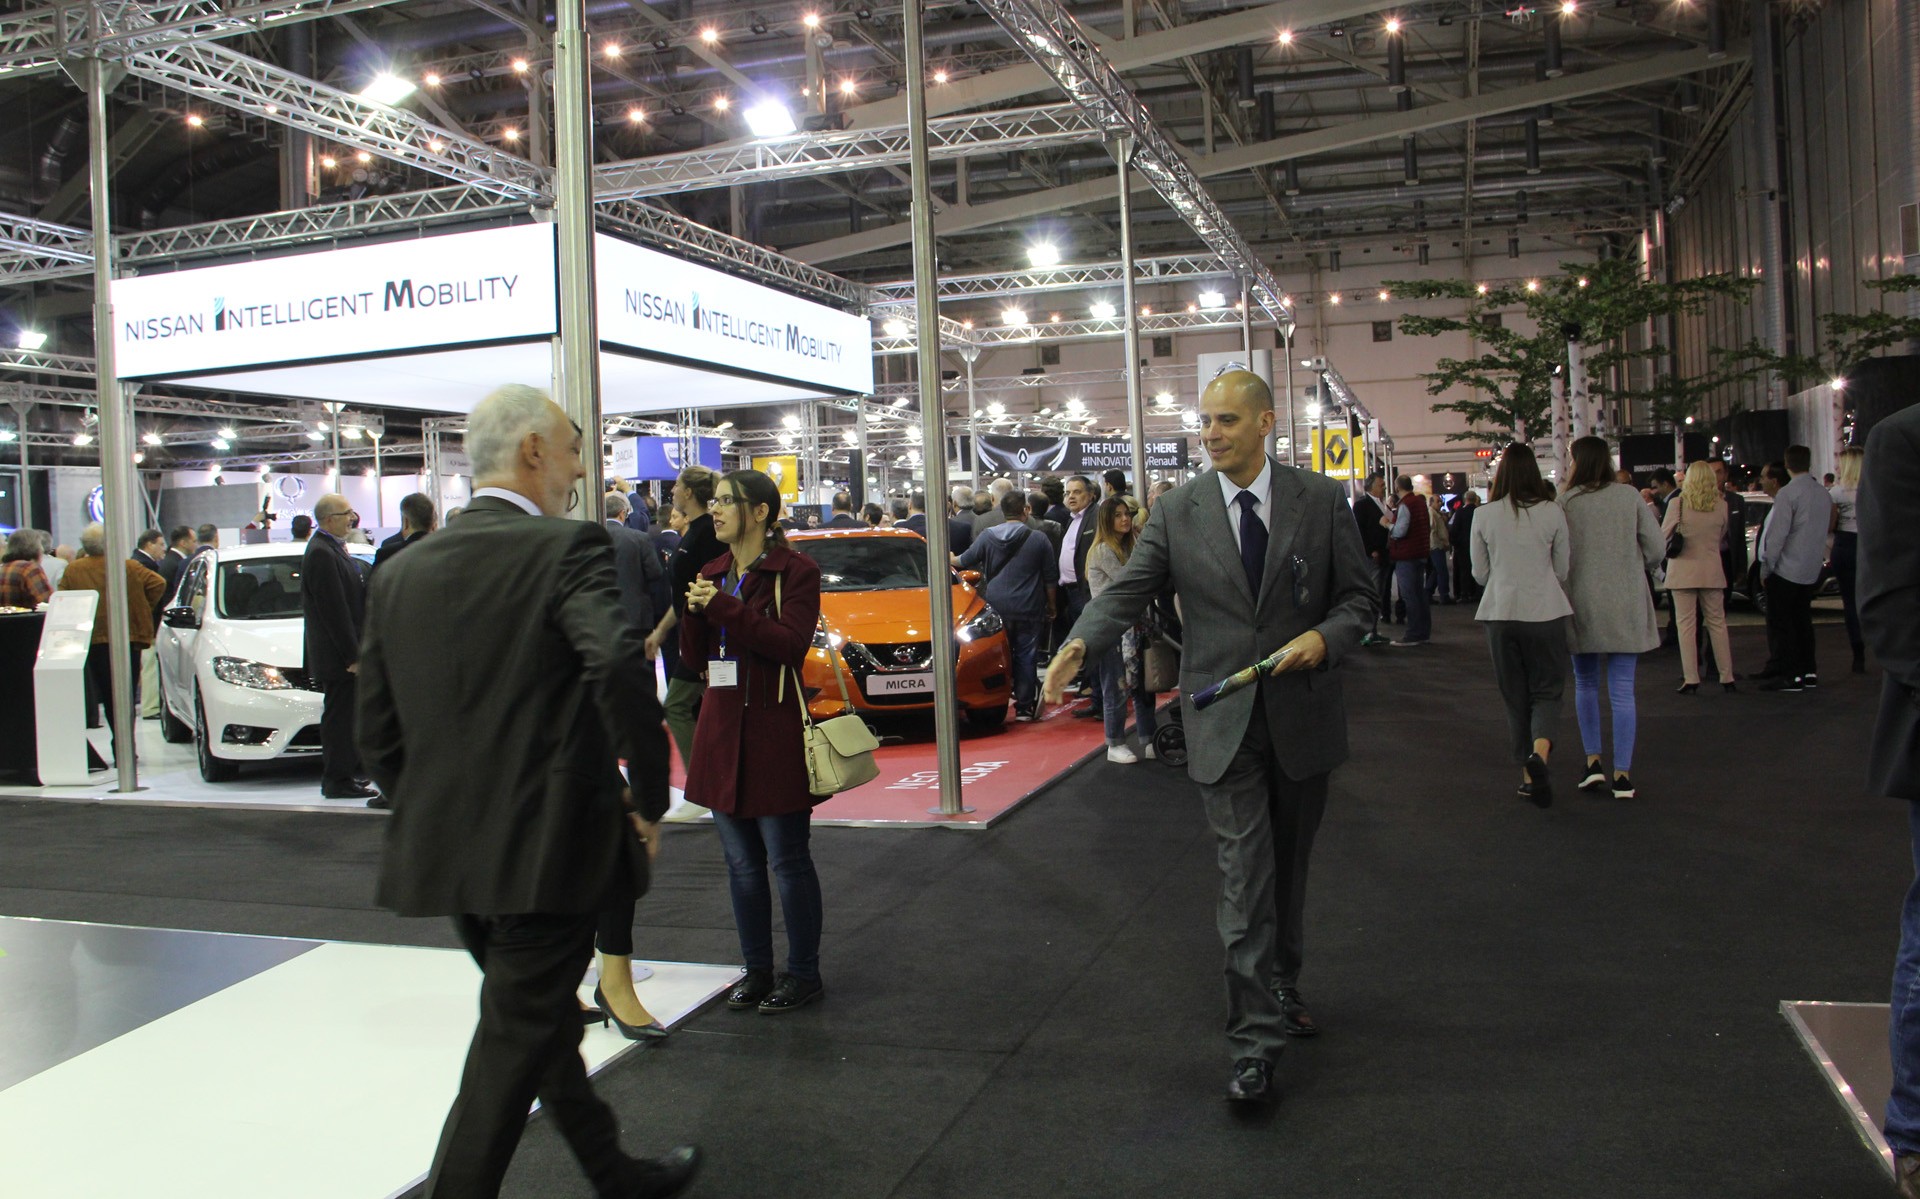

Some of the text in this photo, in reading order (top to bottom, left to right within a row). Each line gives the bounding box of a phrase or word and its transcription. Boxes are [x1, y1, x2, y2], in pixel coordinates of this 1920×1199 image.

[126, 275, 518, 341] NISSAN INTELLIGENT MOBILITY
[625, 288, 842, 363] NISSAN INTELLIGENT MOBILITY
[1081, 443, 1101, 453] THE
[1103, 443, 1132, 453] FUTU
[1153, 443, 1178, 453] HERE
[1317, 468, 1359, 477] ENAUT
[886, 679, 926, 689] MICRA
